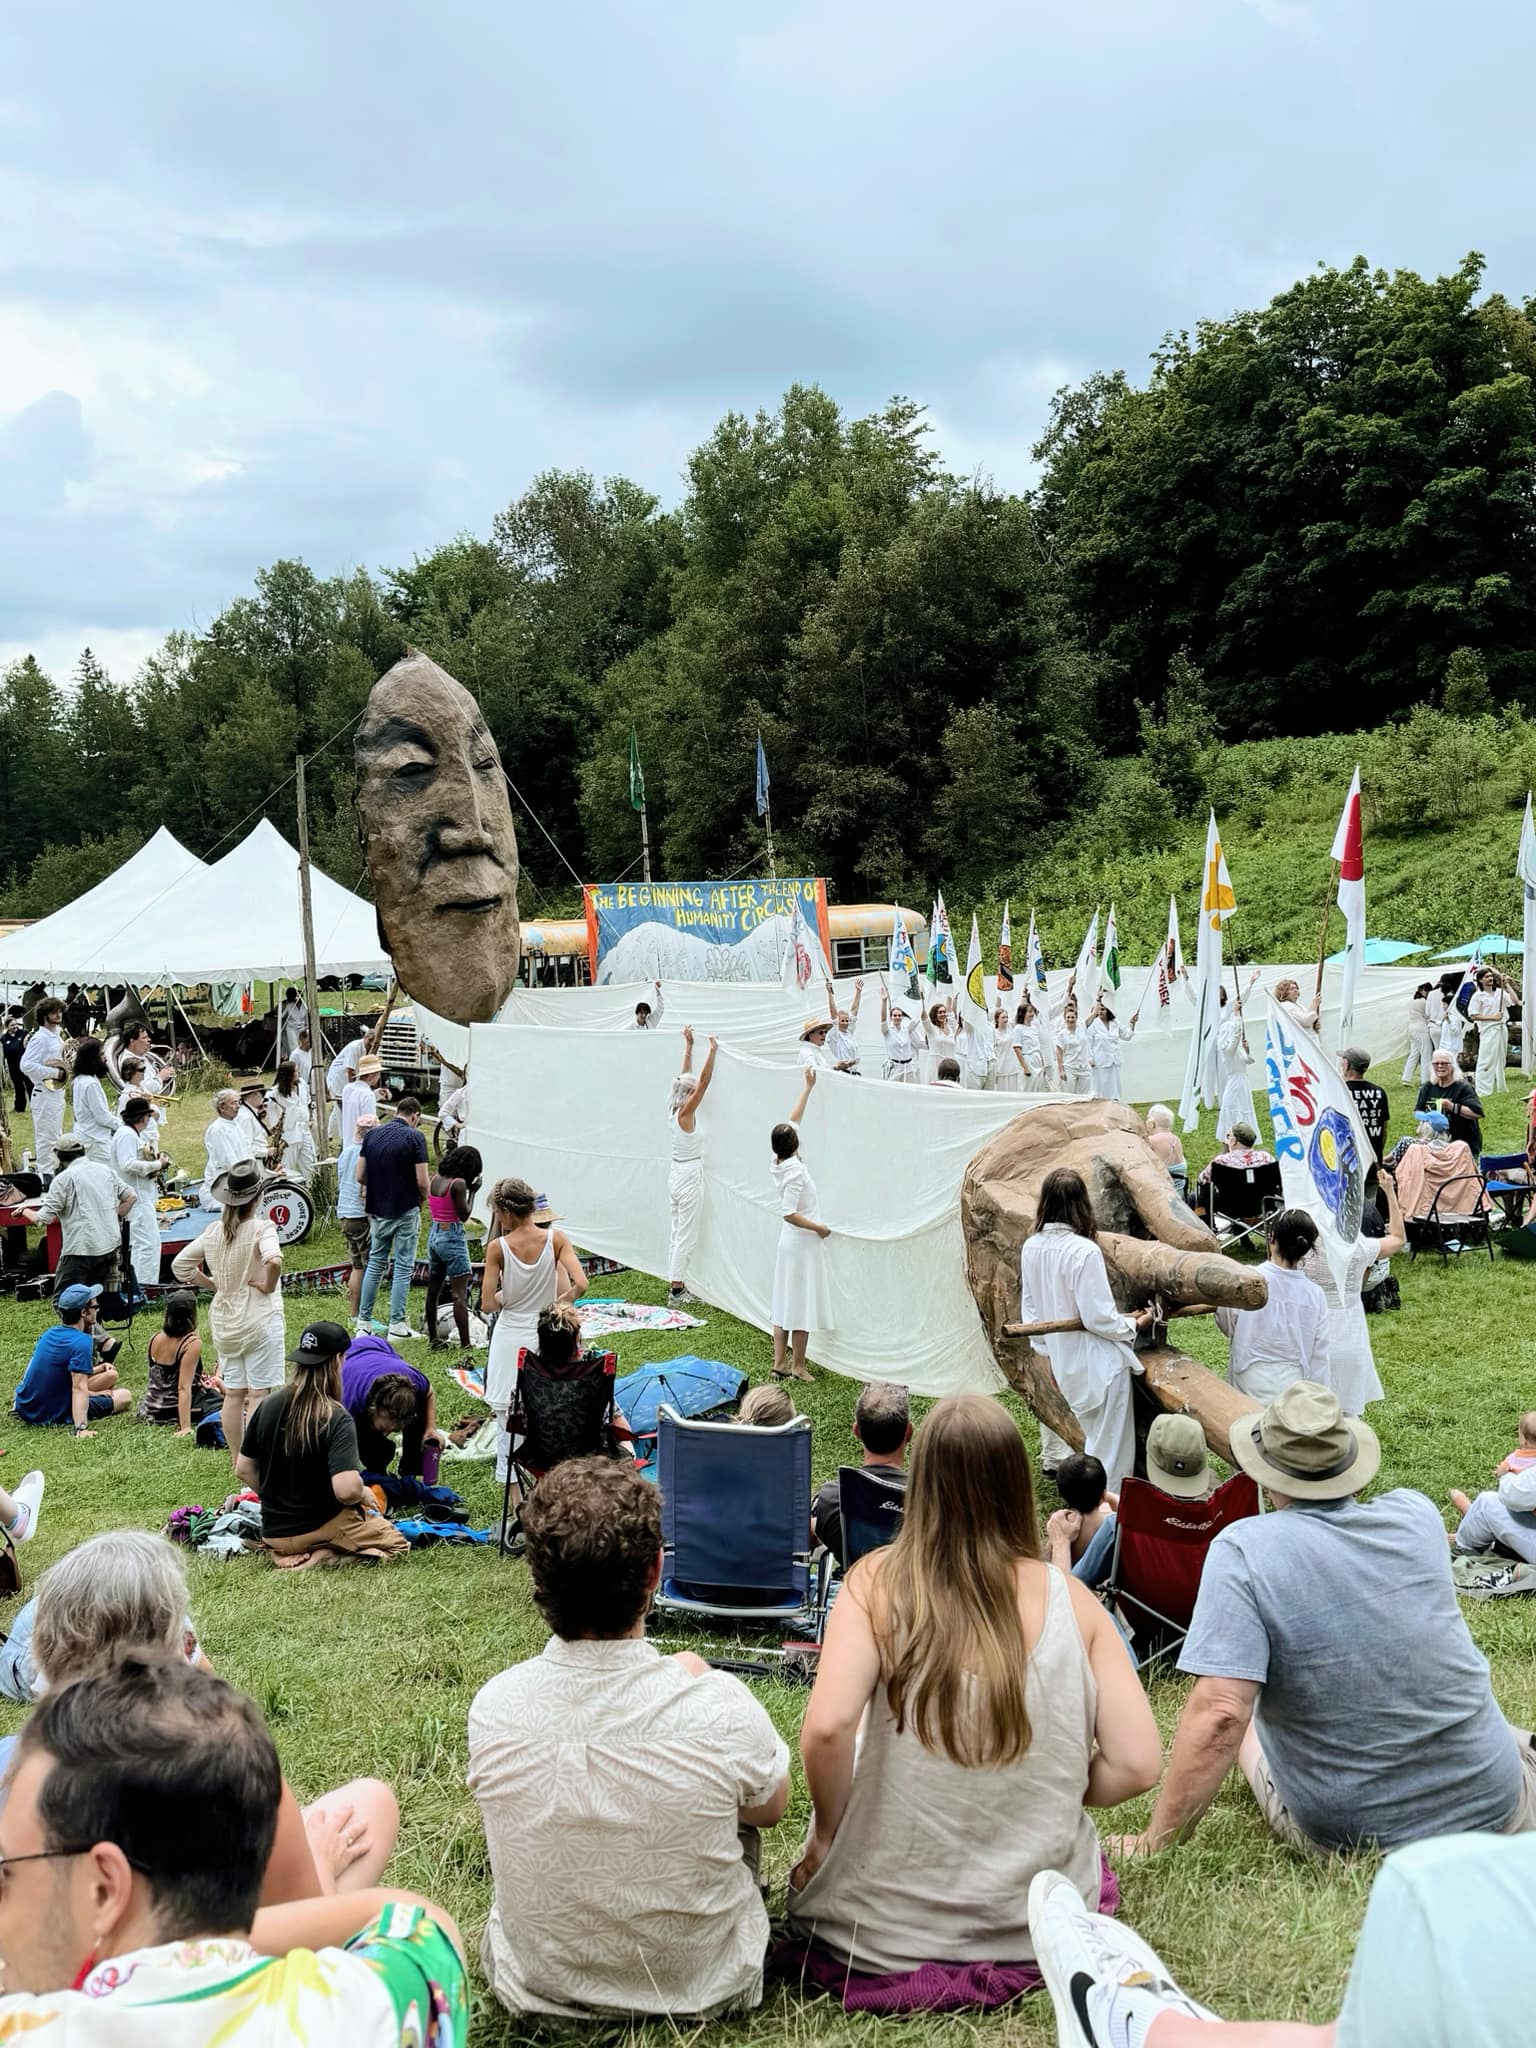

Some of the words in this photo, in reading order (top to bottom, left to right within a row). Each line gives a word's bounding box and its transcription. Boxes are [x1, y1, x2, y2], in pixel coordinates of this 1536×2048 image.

[590, 889, 614, 910] THE
[617, 883, 704, 909] BEGINNING
[710, 884, 758, 911] AFTER
[760, 882, 782, 897] THE
[782, 880, 801, 898] END
[803, 881, 821, 904] OF
[674, 908, 739, 930] HUMANITY
[741, 898, 796, 932] CIRCUS
[1353, 1089, 1382, 1100] EWS
